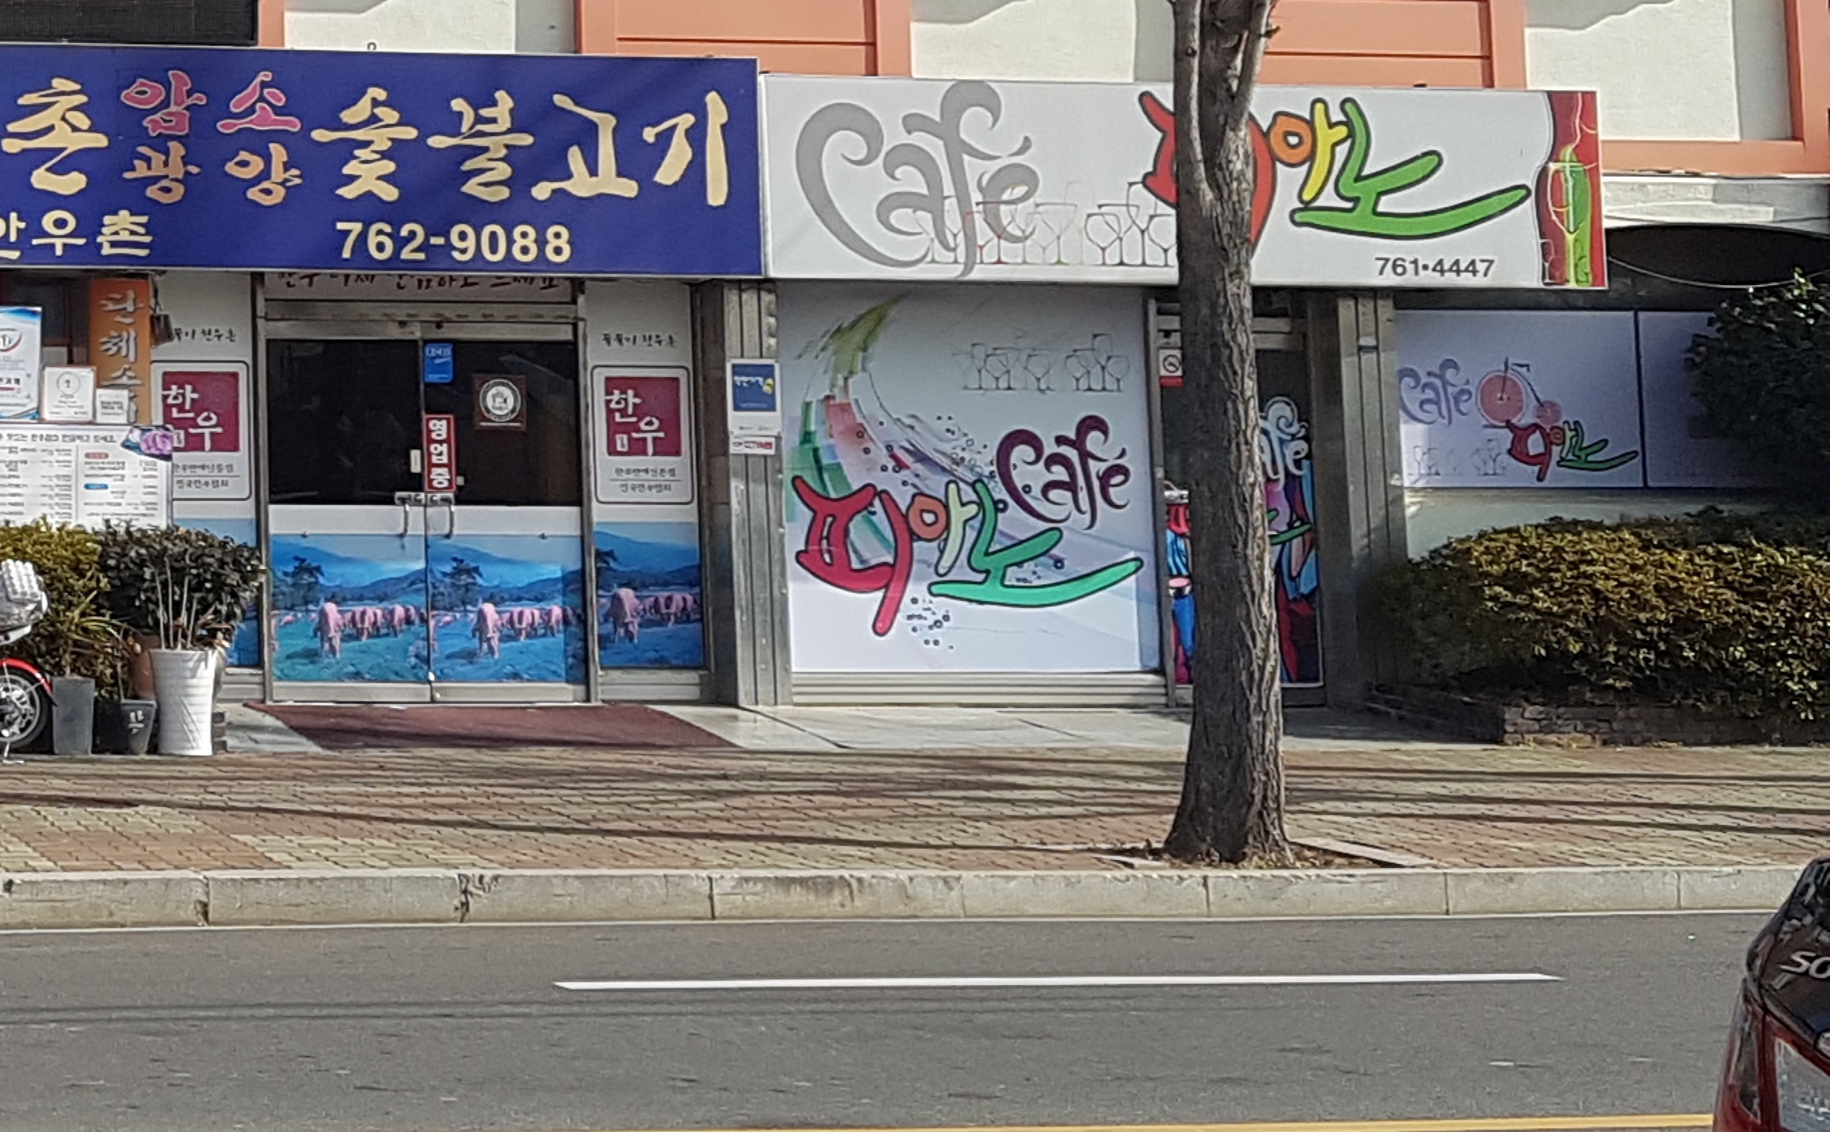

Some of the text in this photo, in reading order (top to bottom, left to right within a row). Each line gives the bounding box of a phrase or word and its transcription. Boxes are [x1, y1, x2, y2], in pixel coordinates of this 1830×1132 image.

[121, 70, 302, 137] 암소
[335, 221, 571, 263] 762-9088
[161, 384, 224, 452] 한우
[605, 388, 666, 457] 한우
[428, 418, 451, 489] 영업중
[791, 476, 1144, 637] 피아노
